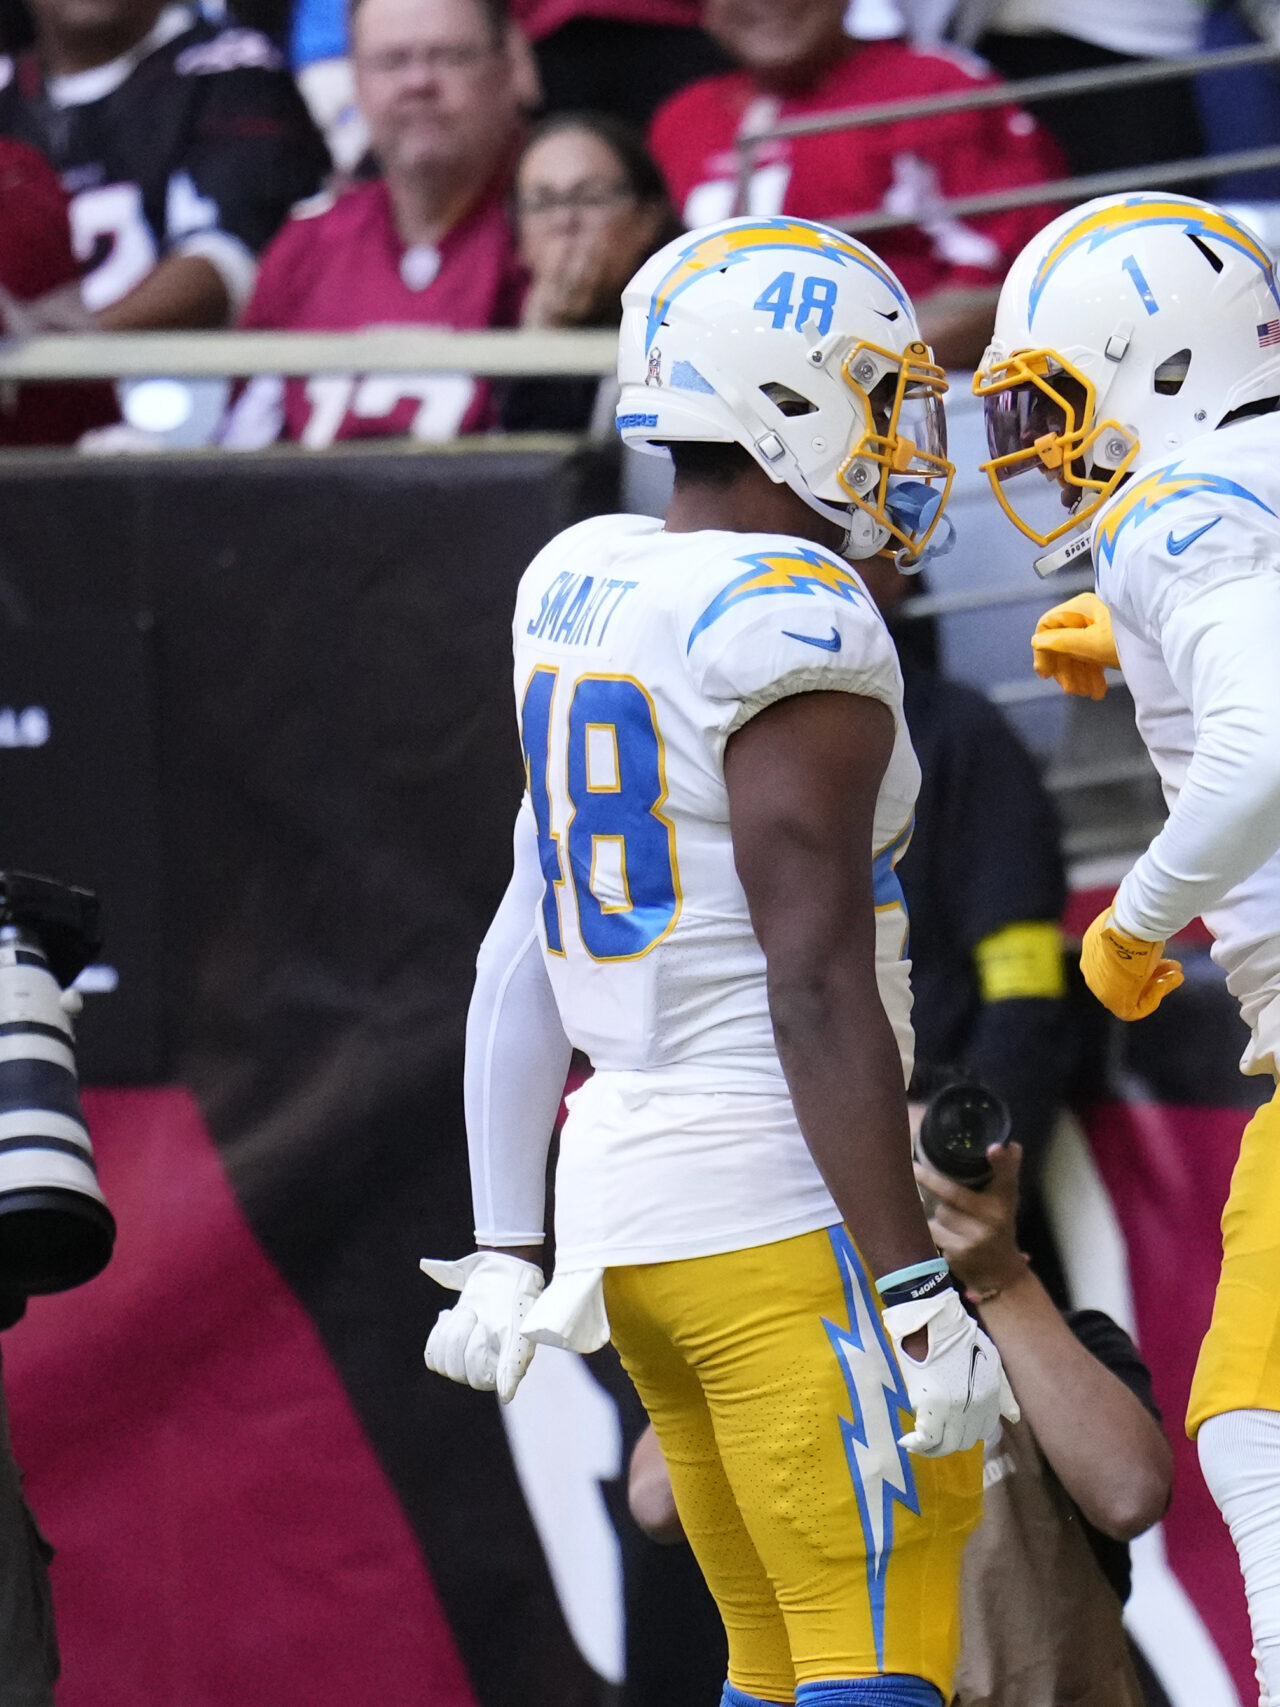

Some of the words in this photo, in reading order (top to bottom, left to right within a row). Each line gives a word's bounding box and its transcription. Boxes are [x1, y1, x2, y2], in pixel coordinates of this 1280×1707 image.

[753, 271, 838, 337] 48
[1121, 254, 1160, 316] 1
[520, 663, 683, 963] 48
